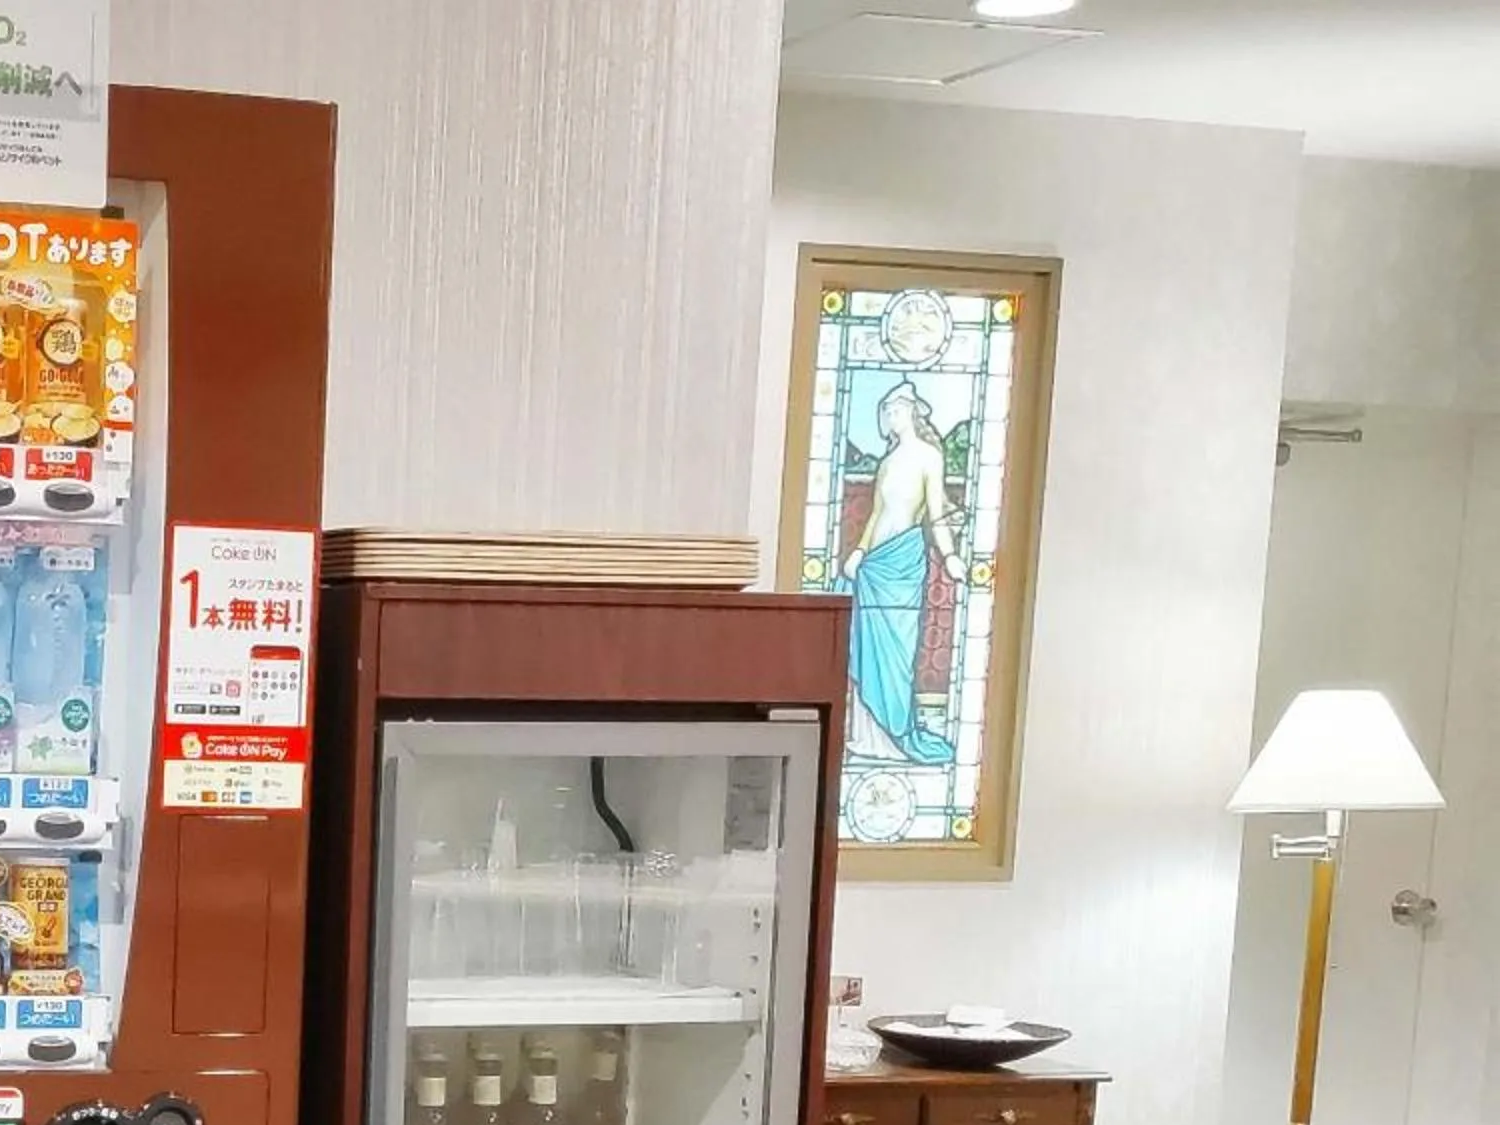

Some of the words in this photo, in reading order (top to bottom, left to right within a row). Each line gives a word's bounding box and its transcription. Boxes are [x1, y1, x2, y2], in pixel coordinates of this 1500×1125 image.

[211, 545, 250, 560] Coke
[206, 743, 237, 756] Coke
[262, 744, 288, 761] Pay
